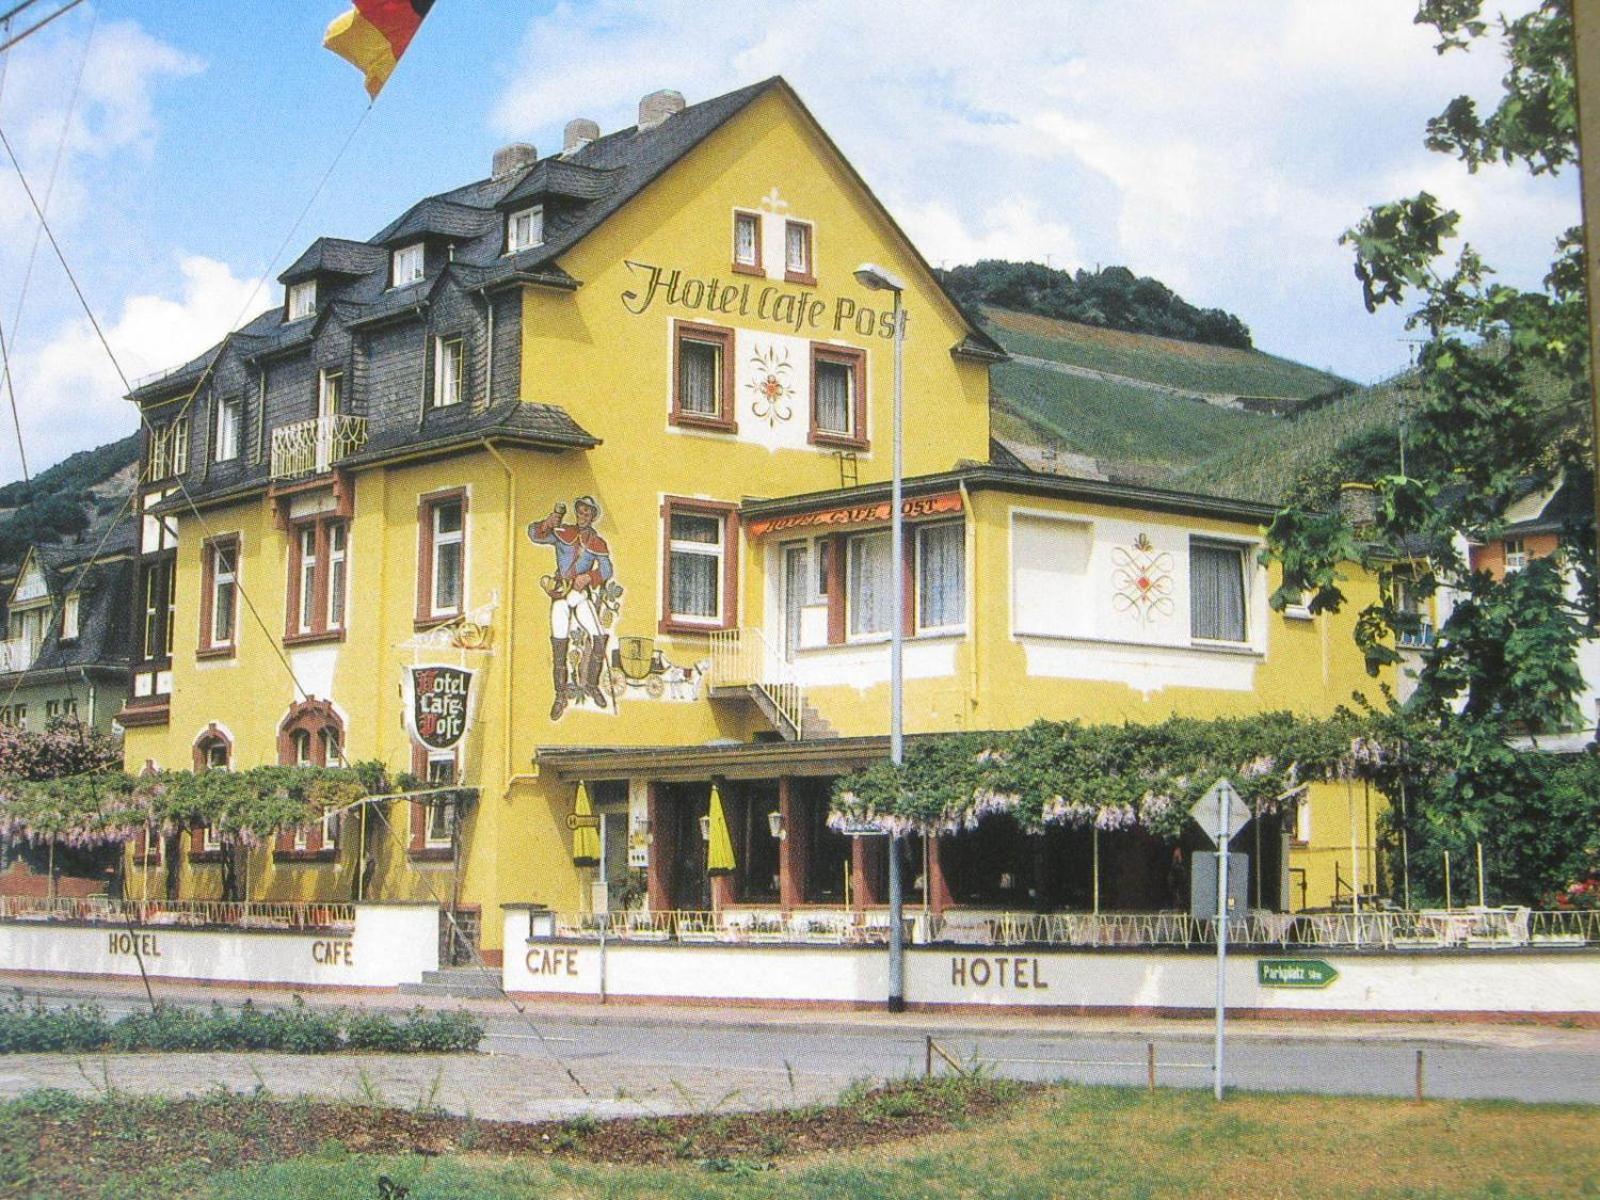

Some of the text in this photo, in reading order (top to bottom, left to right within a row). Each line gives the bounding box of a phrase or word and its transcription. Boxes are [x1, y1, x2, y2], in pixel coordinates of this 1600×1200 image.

[621, 259, 750, 315] Hotel
[757, 286, 826, 333] Cafe
[887, 498, 940, 516] OST
[416, 670, 467, 695] Hotel
[420, 692, 464, 716] Cafe
[419, 714, 462, 739] Post
[108, 933, 162, 957] HOTEL
[312, 941, 354, 965] CAFE
[525, 950, 578, 975] CAFE
[951, 957, 1048, 988] HOTEL
